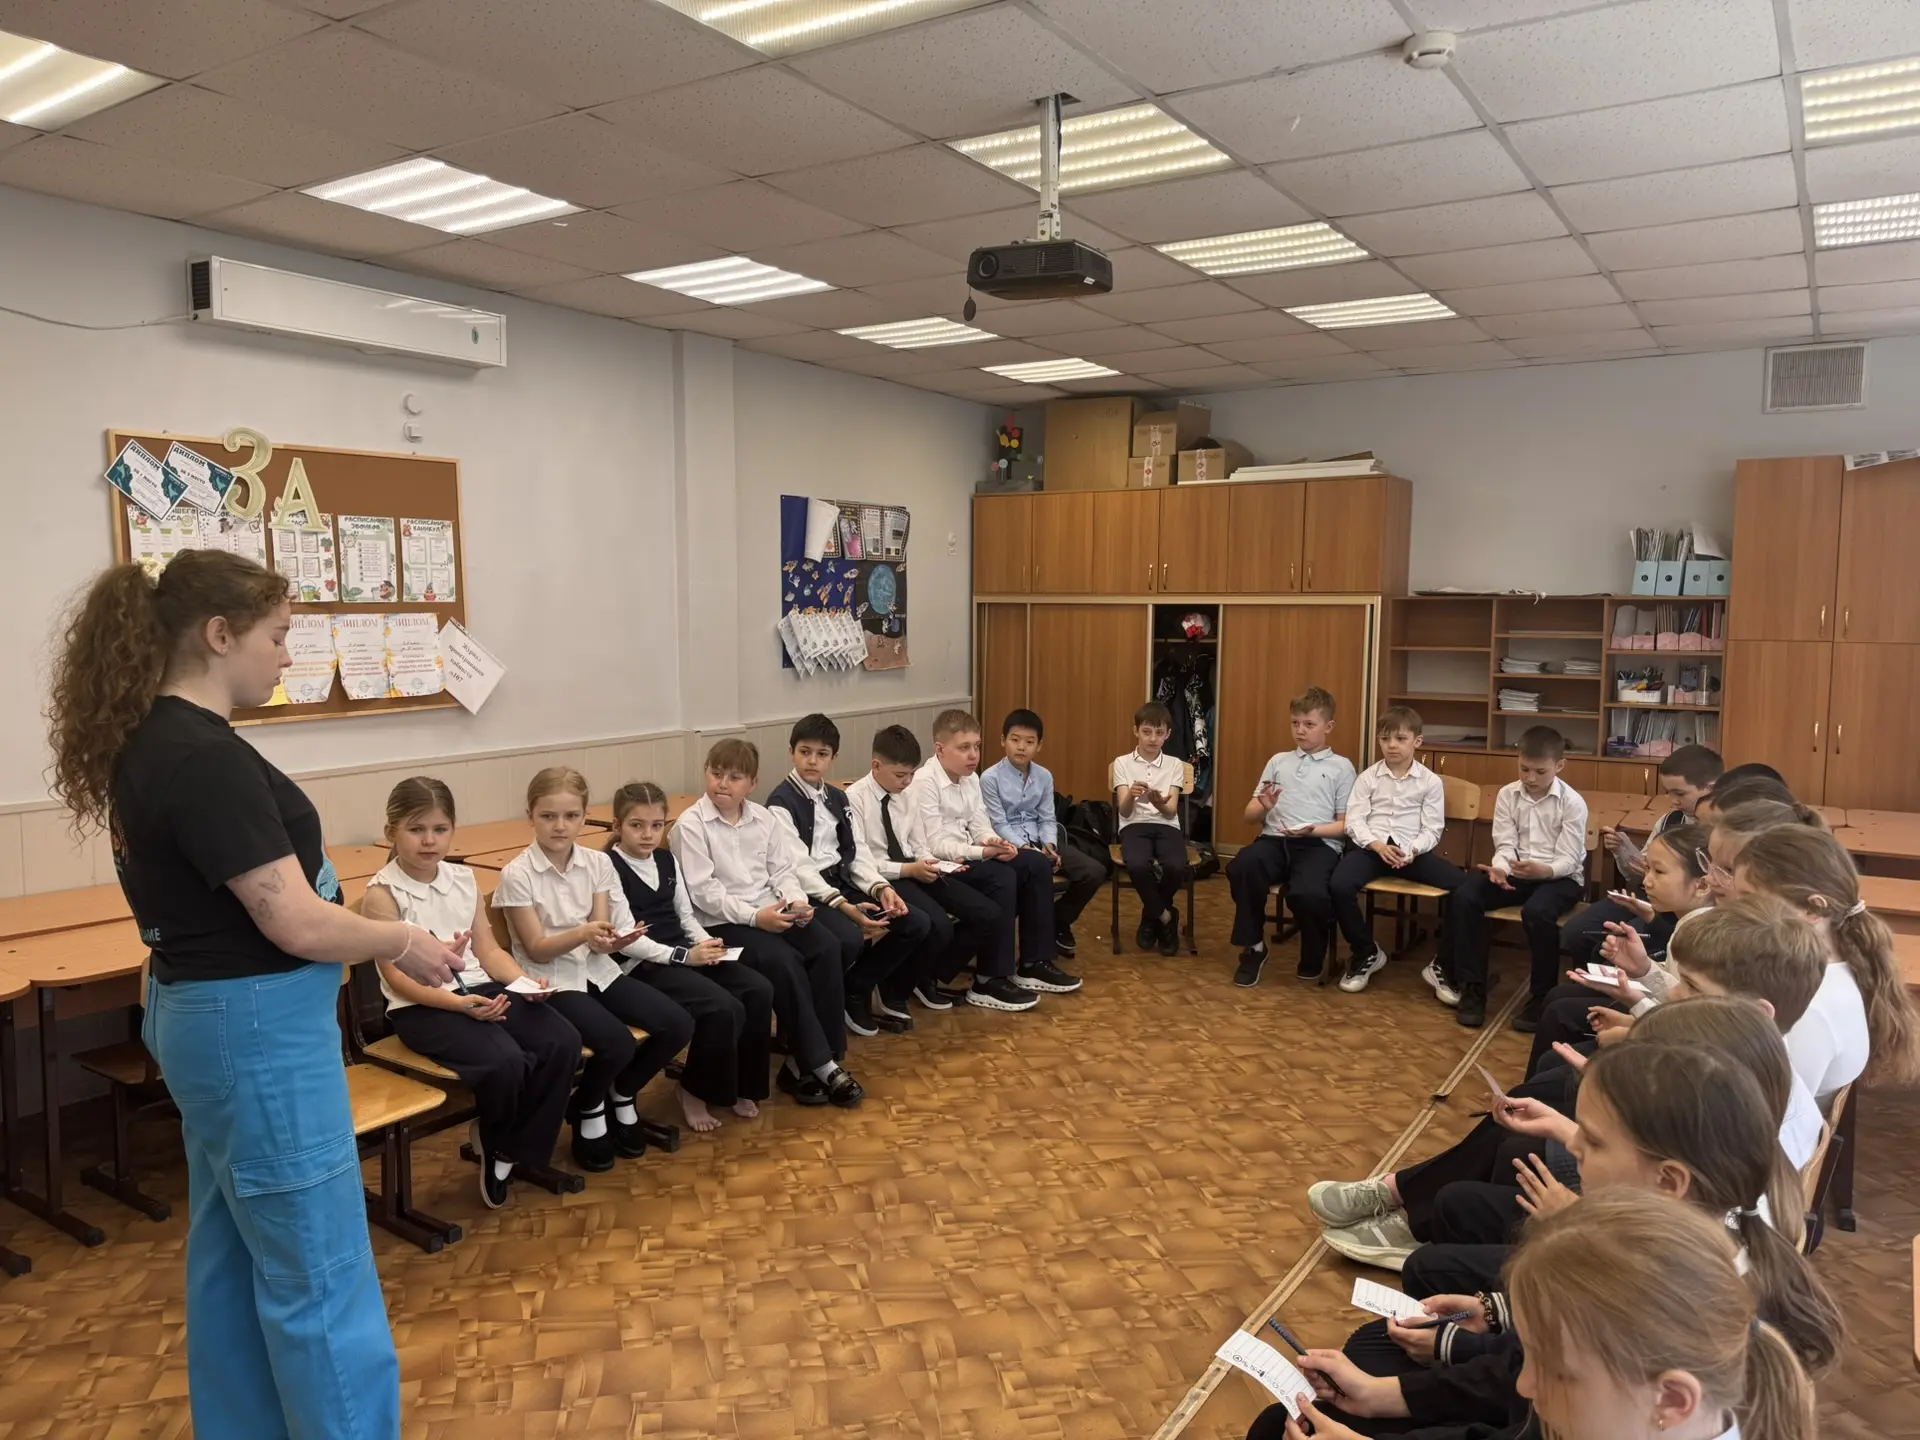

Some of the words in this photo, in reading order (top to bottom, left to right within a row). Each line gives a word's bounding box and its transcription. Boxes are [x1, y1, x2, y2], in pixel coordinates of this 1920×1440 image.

[129, 444, 161, 473] ДИПЛОМ
[173, 445, 206, 468] ДИПЛОМ
[290, 619, 325, 629] ИПЛОМ
[340, 618, 379, 629] ДИПЛОМ
[393, 617, 430, 628] ДИПЛОМ
